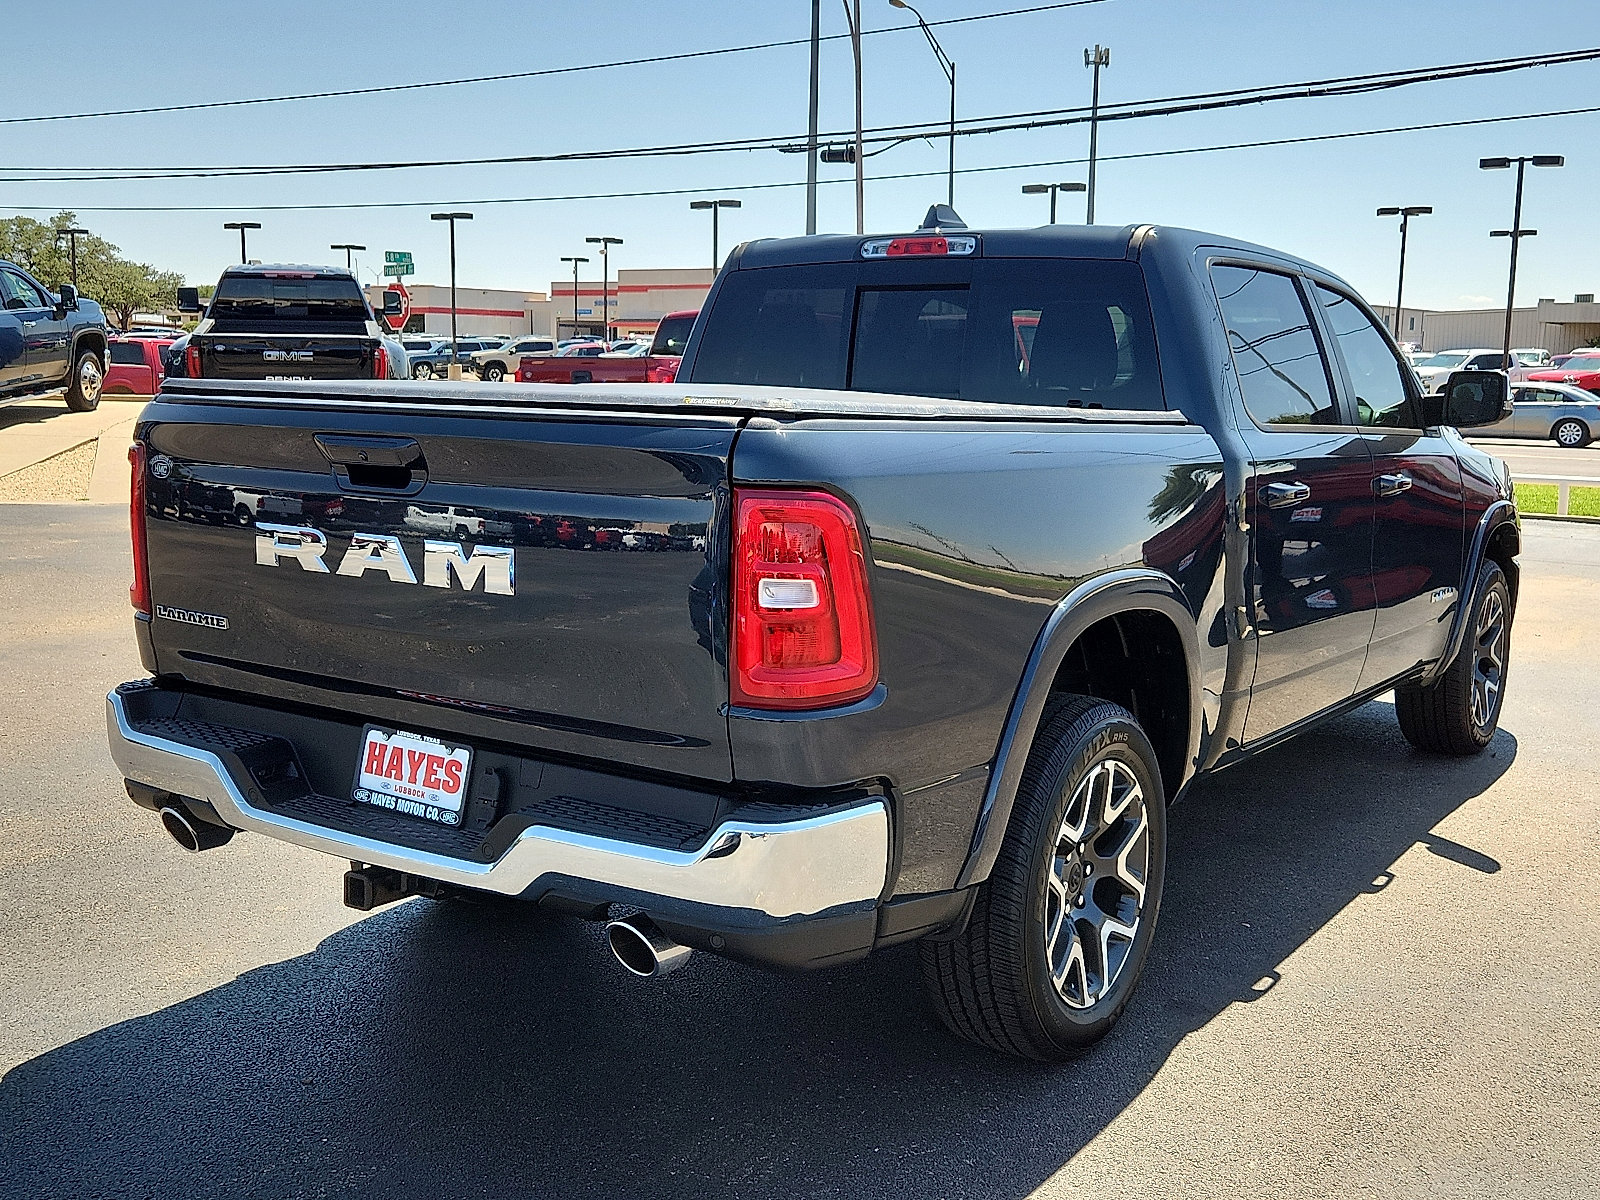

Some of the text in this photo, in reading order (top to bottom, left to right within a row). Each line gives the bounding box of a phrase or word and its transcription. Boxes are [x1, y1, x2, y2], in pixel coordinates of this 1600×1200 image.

[263, 350, 314, 362] GMC
[255, 521, 517, 597] RAM
[156, 605, 231, 630] LARAMIE
[1081, 726, 1112, 766] HTX
[364, 740, 463, 794] HAYES
[393, 784, 426, 799] LUBBOCK
[370, 792, 440, 821] HAYES MOTOR CO.
